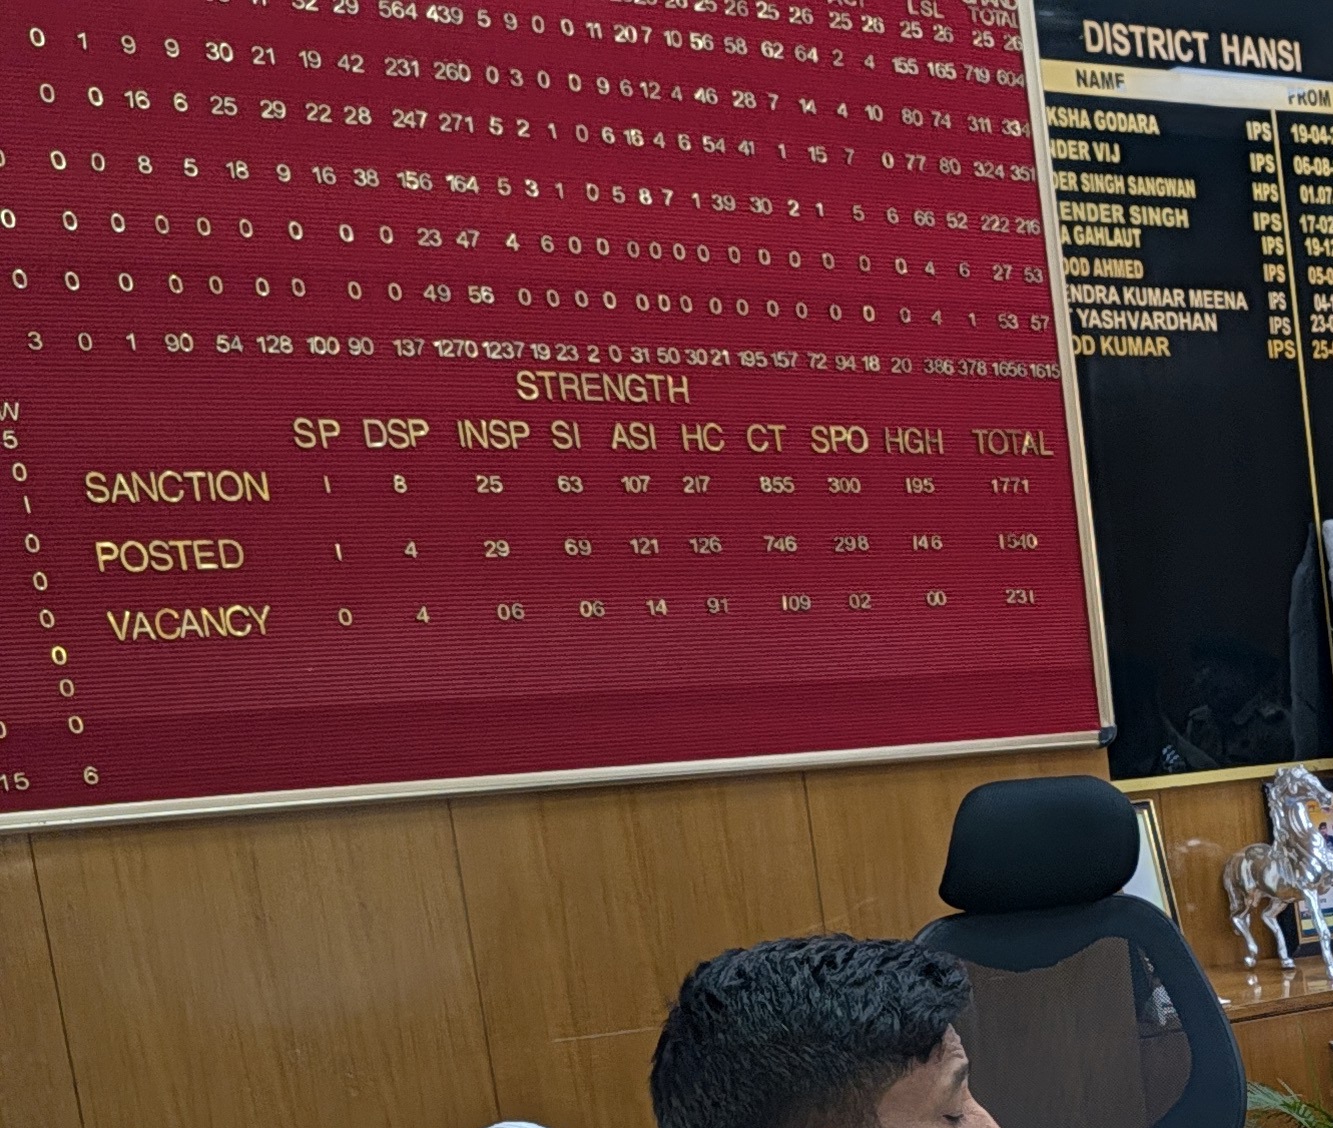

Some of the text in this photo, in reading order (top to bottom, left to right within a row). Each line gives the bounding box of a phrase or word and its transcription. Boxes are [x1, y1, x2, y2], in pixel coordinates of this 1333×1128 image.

[1082, 19, 1302, 73] DISTRICT HANSI
[1046, 106, 1091, 130] KSHA
[1093, 109, 1161, 135] GODARA
[1246, 120, 1272, 142] IPS
[1091, 141, 1121, 164] VIJ
[1250, 152, 1276, 174] IPS
[1079, 172, 1126, 195] SINGH
[1126, 175, 1197, 199] SANGWAN
[1251, 182, 1280, 203] HPS
[1128, 204, 1190, 229] SINGH
[1253, 211, 1283, 233] IPS
[1073, 225, 1142, 248] GAHLAUT
[1261, 235, 1285, 256] IPS
[1093, 257, 1144, 280] AHMED
[1262, 263, 1286, 284] IPS
[1122, 286, 1187, 308] KUMAR
[1188, 288, 1249, 311] MEENA
[1267, 291, 1287, 311] IPS
[1077, 308, 1218, 332] YASHVARDHAN
[1268, 315, 1292, 336] IPS
[529, 343, 552, 361] 19
[554, 343, 580, 362] 23
[587, 345, 601, 364] 2
[608, 344, 623, 364] 0
[630, 346, 650, 364] 31
[656, 346, 681, 365] 50
[684, 348, 709, 366] 30
[710, 348, 731, 366] 21
[737, 349, 769, 368] 195
[770, 350, 799, 369] 157
[807, 351, 828, 370] 72
[835, 355, 857, 371] 94
[861, 355, 881, 372] 18
[890, 356, 913, 374] 20
[924, 357, 956, 376] 386
[958, 358, 988, 377] 378
[991, 360, 1028, 377] 1656
[1099, 334, 1171, 357] KUMAR
[1267, 339, 1296, 360] IPS
[516, 370, 690, 404] STRENGTH
[293, 417, 1054, 456] SP DSP INSP SI ASI HC CT SPO HGH TOTAL
[84, 469, 271, 504] SANCTION
[393, 474, 408, 494] 8
[475, 474, 504, 494] 25
[557, 475, 584, 493] 63
[620, 474, 651, 494] 107
[759, 475, 795, 494] 855
[827, 476, 862, 494] 300
[905, 477, 936, 494] 195
[991, 477, 1030, 494] 1771
[94, 538, 245, 572] POSTED
[404, 541, 418, 558] 4
[483, 539, 510, 558] 29
[564, 537, 592, 556] 69
[629, 537, 660, 555] 121
[688, 534, 723, 554] 126
[763, 535, 798, 552] 746
[834, 535, 870, 553] 298
[912, 534, 944, 551] 146
[998, 533, 1039, 550] 1540
[105, 588, 1035, 642] VACANCY 0 4 06 06 14 91 109 02 00 231
